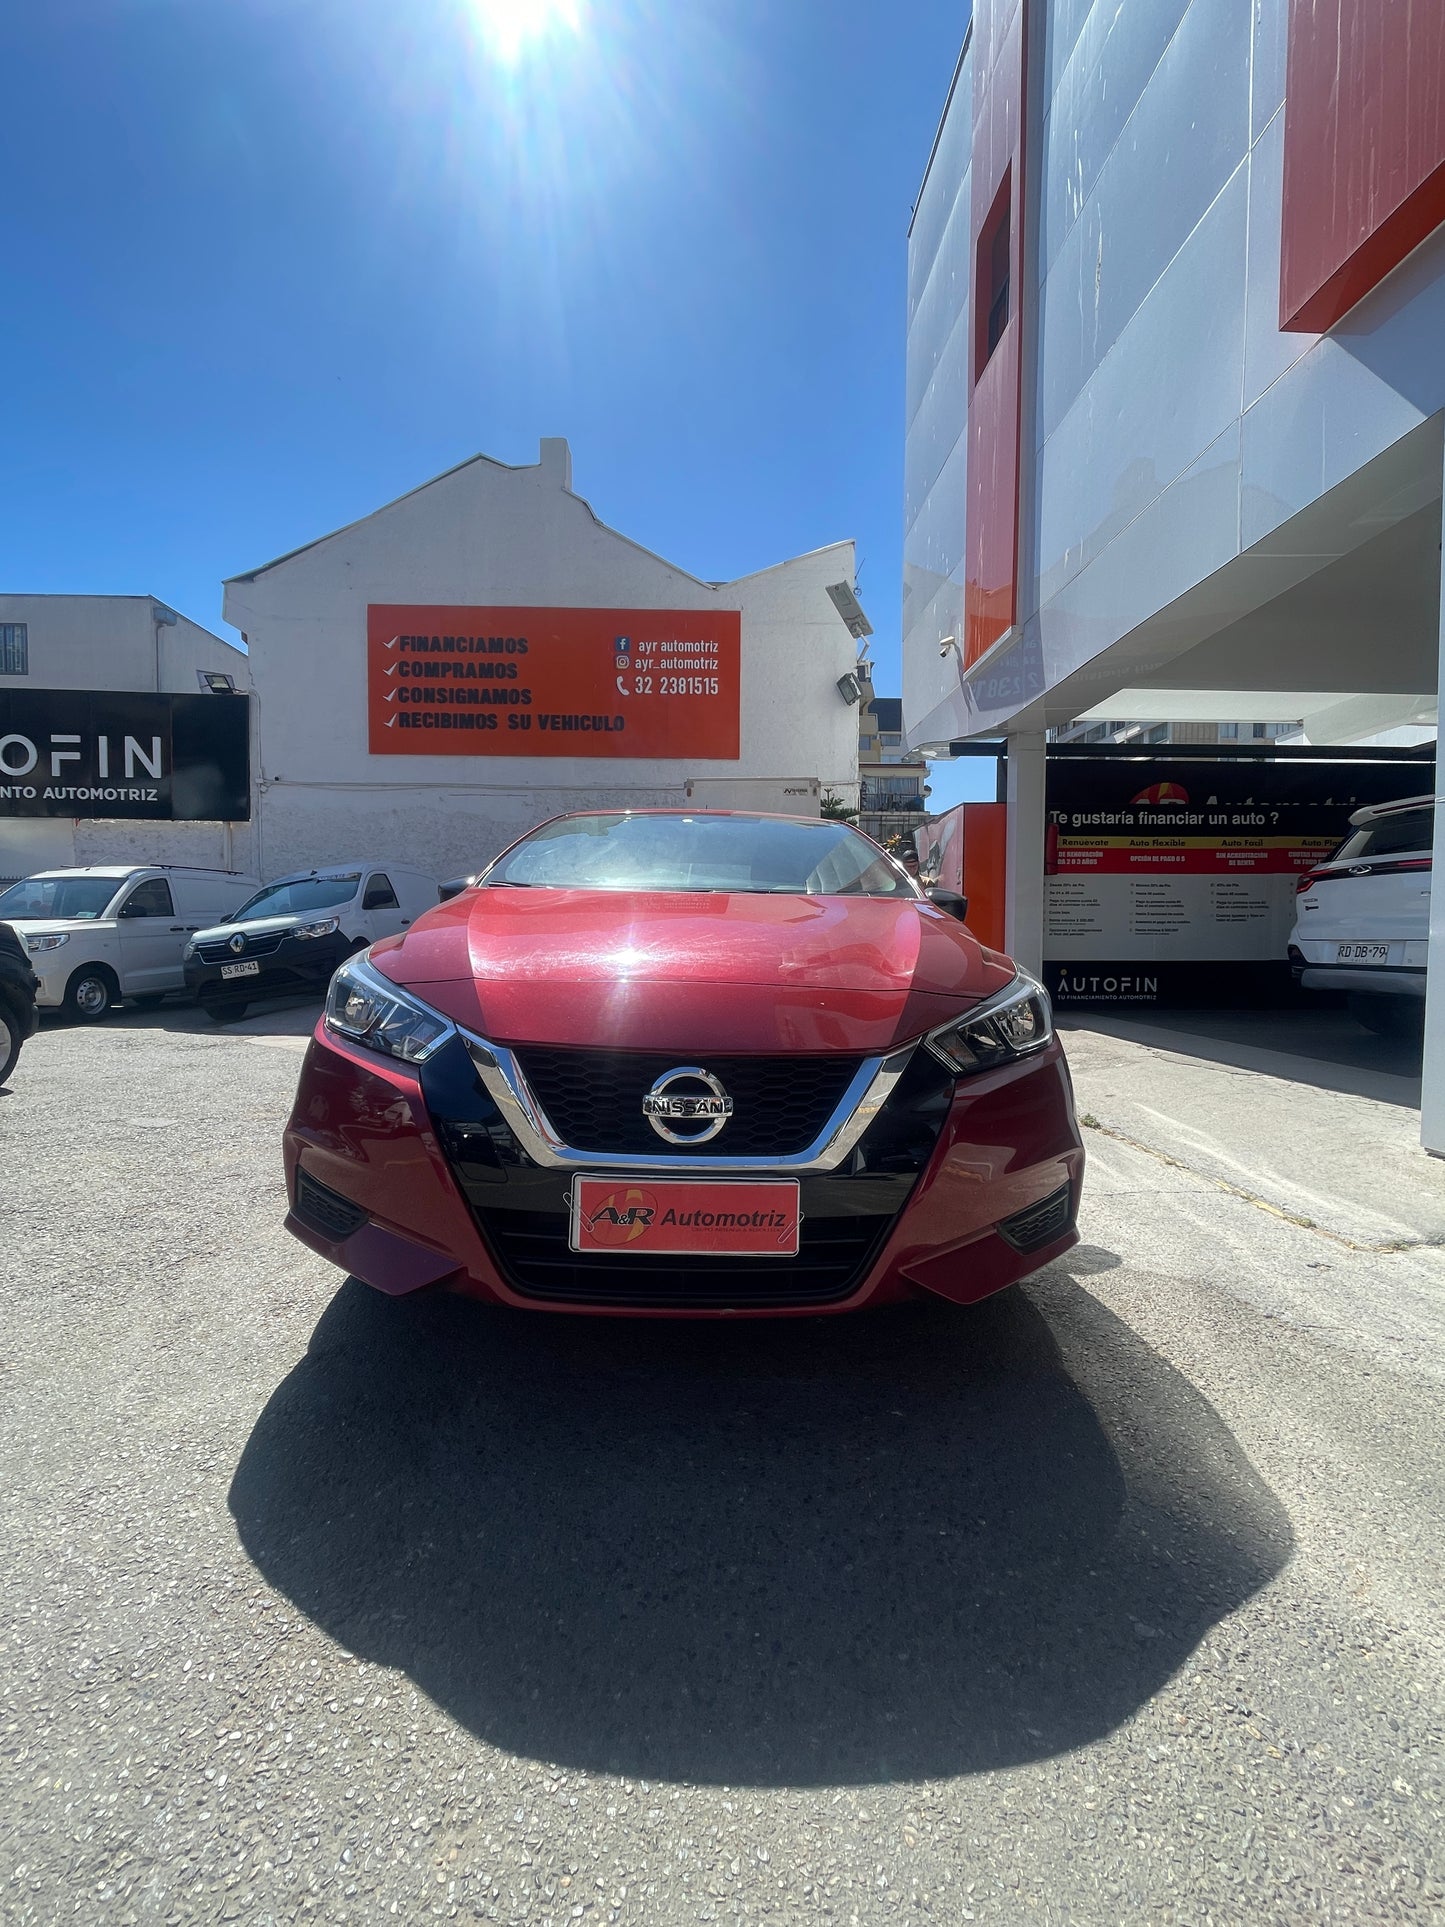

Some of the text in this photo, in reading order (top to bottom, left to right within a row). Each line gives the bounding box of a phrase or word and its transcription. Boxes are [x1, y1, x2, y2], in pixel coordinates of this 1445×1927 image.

[399, 635, 529, 654] FINANCIAMOS
[638, 639, 719, 655] ayr automotriz
[398, 660, 519, 680] COMPRAMOS
[635, 656, 718, 672] ayr_automotriz
[635, 676, 719, 695] 32 2381515
[397, 686, 533, 706] CONSIGNAMOS
[398, 711, 625, 732] RECIBIMOS SU VEHICULO
[0, 733, 162, 779] OFIN
[42, 786, 158, 801] AUTOMOTRIZ
[1050, 810, 1280, 828] Te gustaría financiar un auto ?
[1129, 838, 1187, 848] Auto Flexible
[1221, 839, 1242, 848] Auto
[1301, 839, 1322, 848] Auto
[1057, 977, 1158, 992] AUTOFIN
[652, 1099, 723, 1115] NISSAN
[590, 1206, 786, 1227] A&R Automotriz
